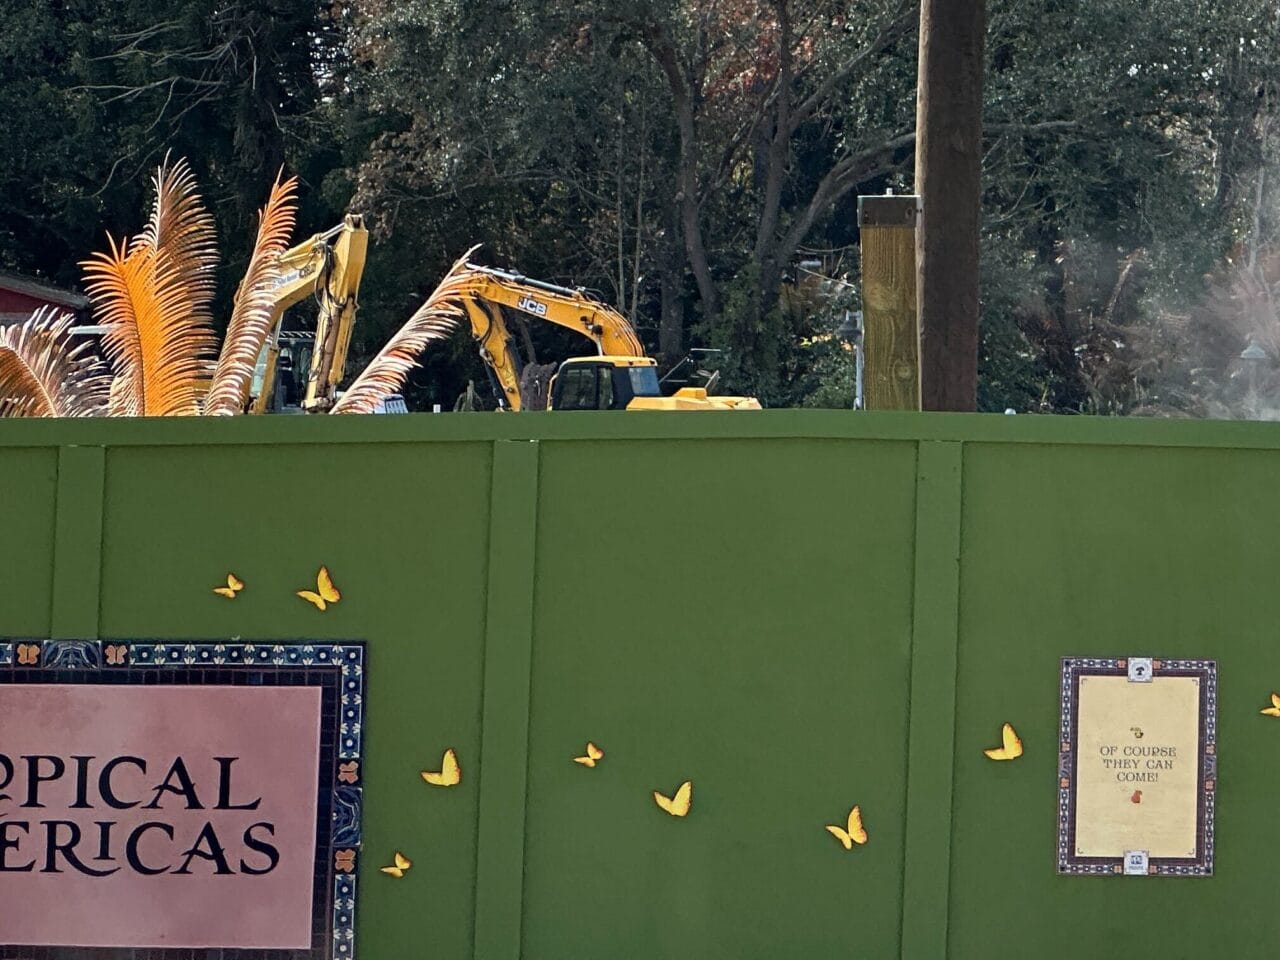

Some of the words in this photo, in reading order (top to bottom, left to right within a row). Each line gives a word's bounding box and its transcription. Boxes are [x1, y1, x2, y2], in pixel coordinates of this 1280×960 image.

[518, 297, 547, 315] JCB
[1100, 746, 1118, 756] OF
[1123, 746, 1176, 757] COURSE
[1103, 759, 1140, 769] THEY
[1146, 759, 1173, 769] CAN
[1116, 772, 1159, 782] COME!
[0, 820, 280, 877] ERICAS
